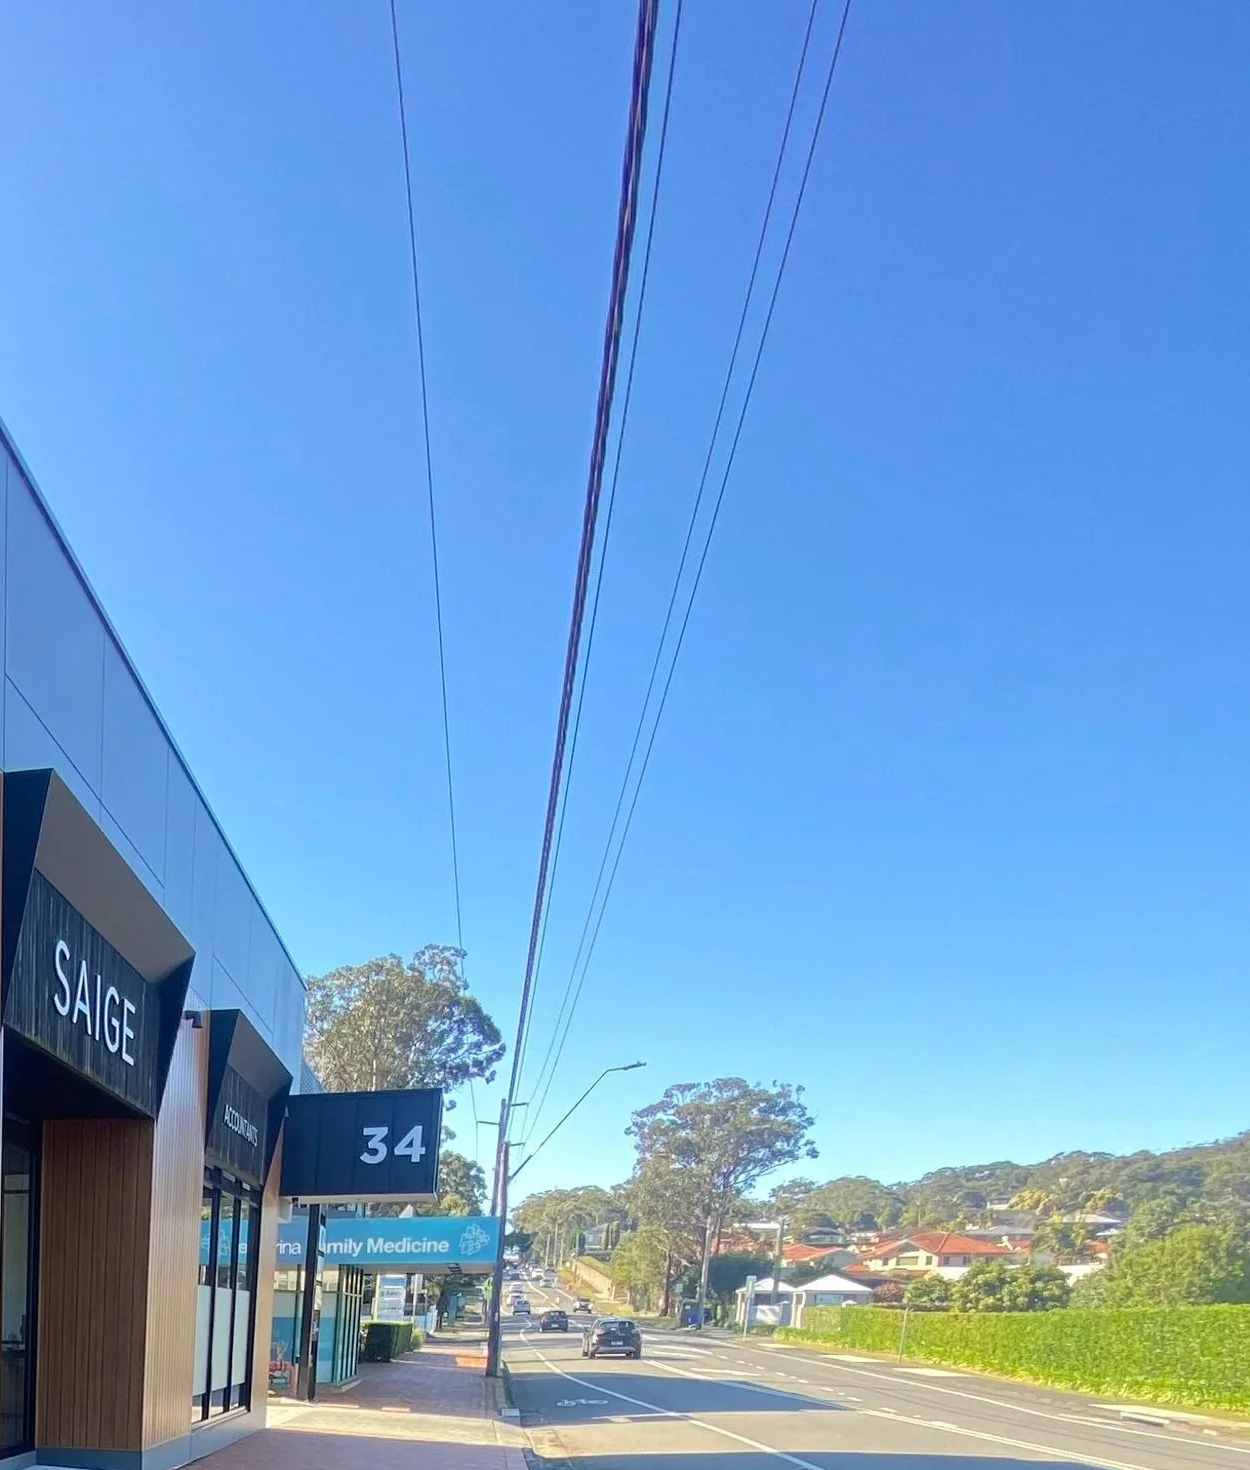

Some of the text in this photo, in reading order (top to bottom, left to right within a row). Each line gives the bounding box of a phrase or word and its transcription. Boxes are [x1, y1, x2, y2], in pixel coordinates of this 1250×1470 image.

[52, 938, 137, 1067] SAIGE
[359, 1125, 426, 1164] 34
[325, 1237, 364, 1258] mily
[366, 1237, 450, 1254] Medicine
